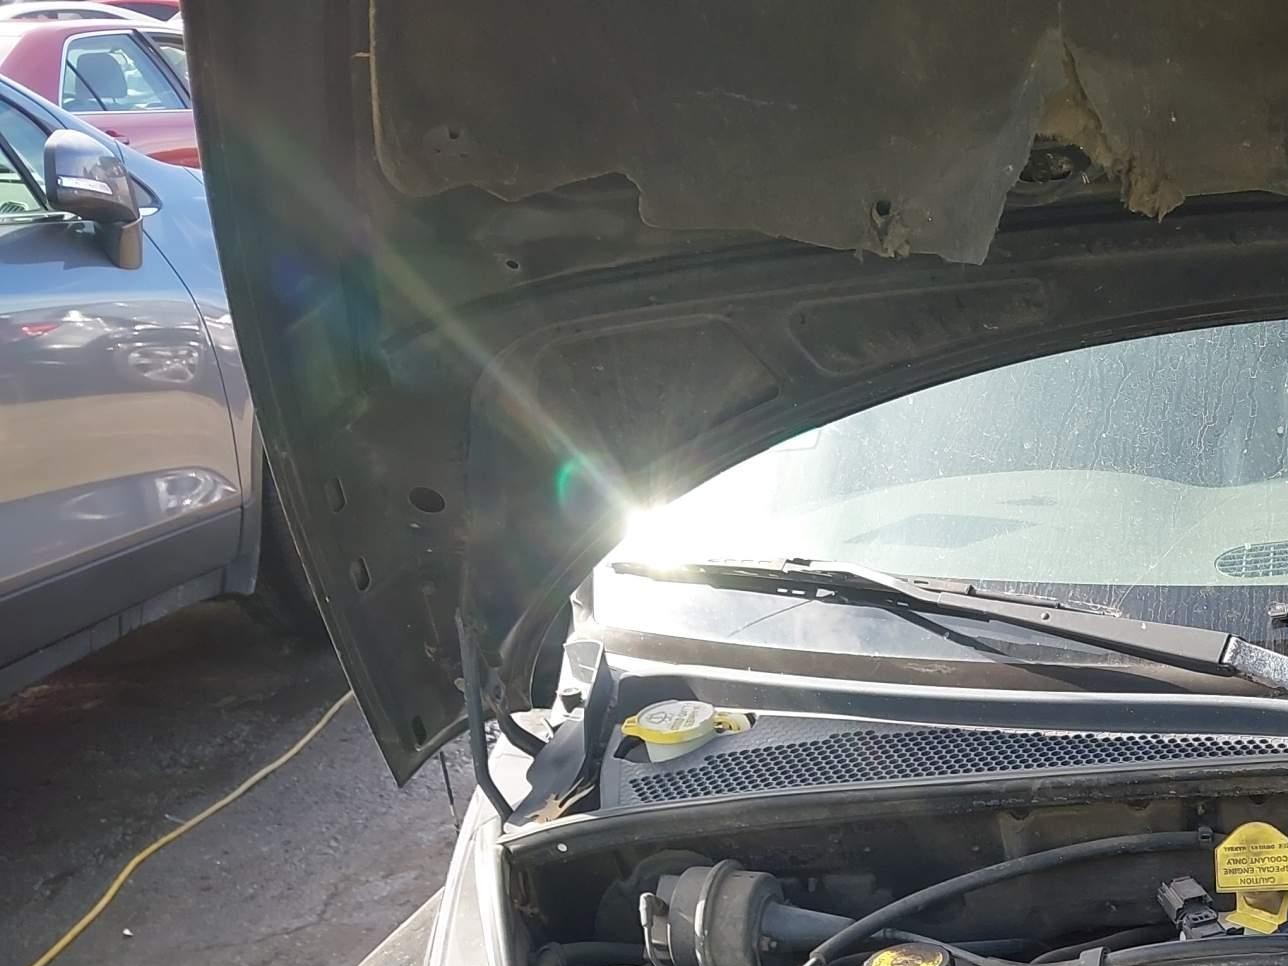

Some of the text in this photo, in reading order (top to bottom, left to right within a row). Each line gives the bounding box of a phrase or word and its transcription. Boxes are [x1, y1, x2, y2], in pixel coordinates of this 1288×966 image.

[1226, 855, 1288, 865] COOLANT ONLY
[1224, 867, 1254, 875] ENGINE
[1239, 876, 1276, 885] CAUTION
